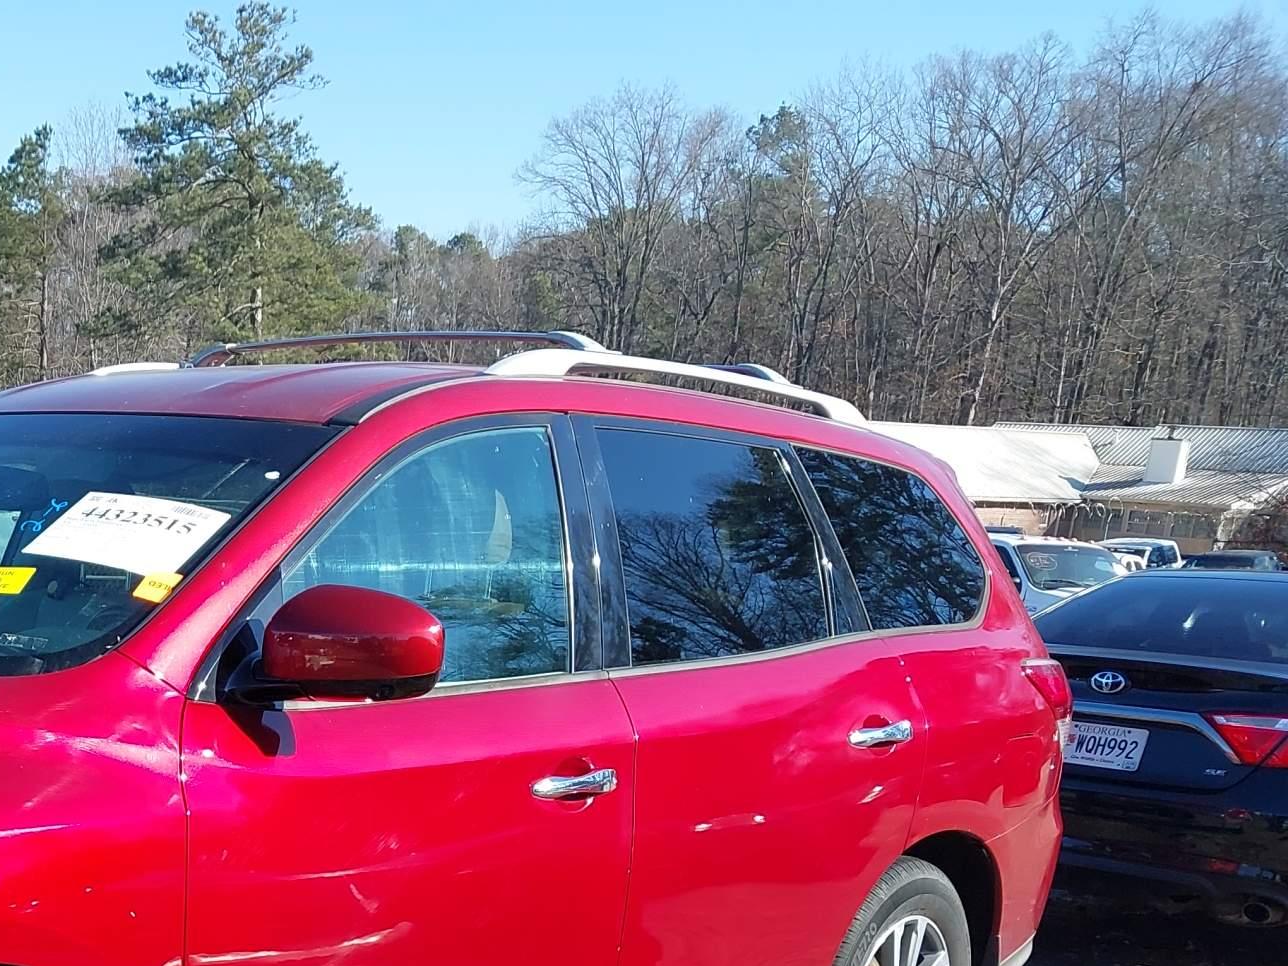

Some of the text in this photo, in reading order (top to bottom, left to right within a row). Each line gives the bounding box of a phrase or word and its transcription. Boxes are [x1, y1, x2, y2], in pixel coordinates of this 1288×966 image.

[81, 506, 197, 534] 44323515
[1078, 723, 1127, 737] GEORGIA
[1075, 733, 1139, 760] WQH992
